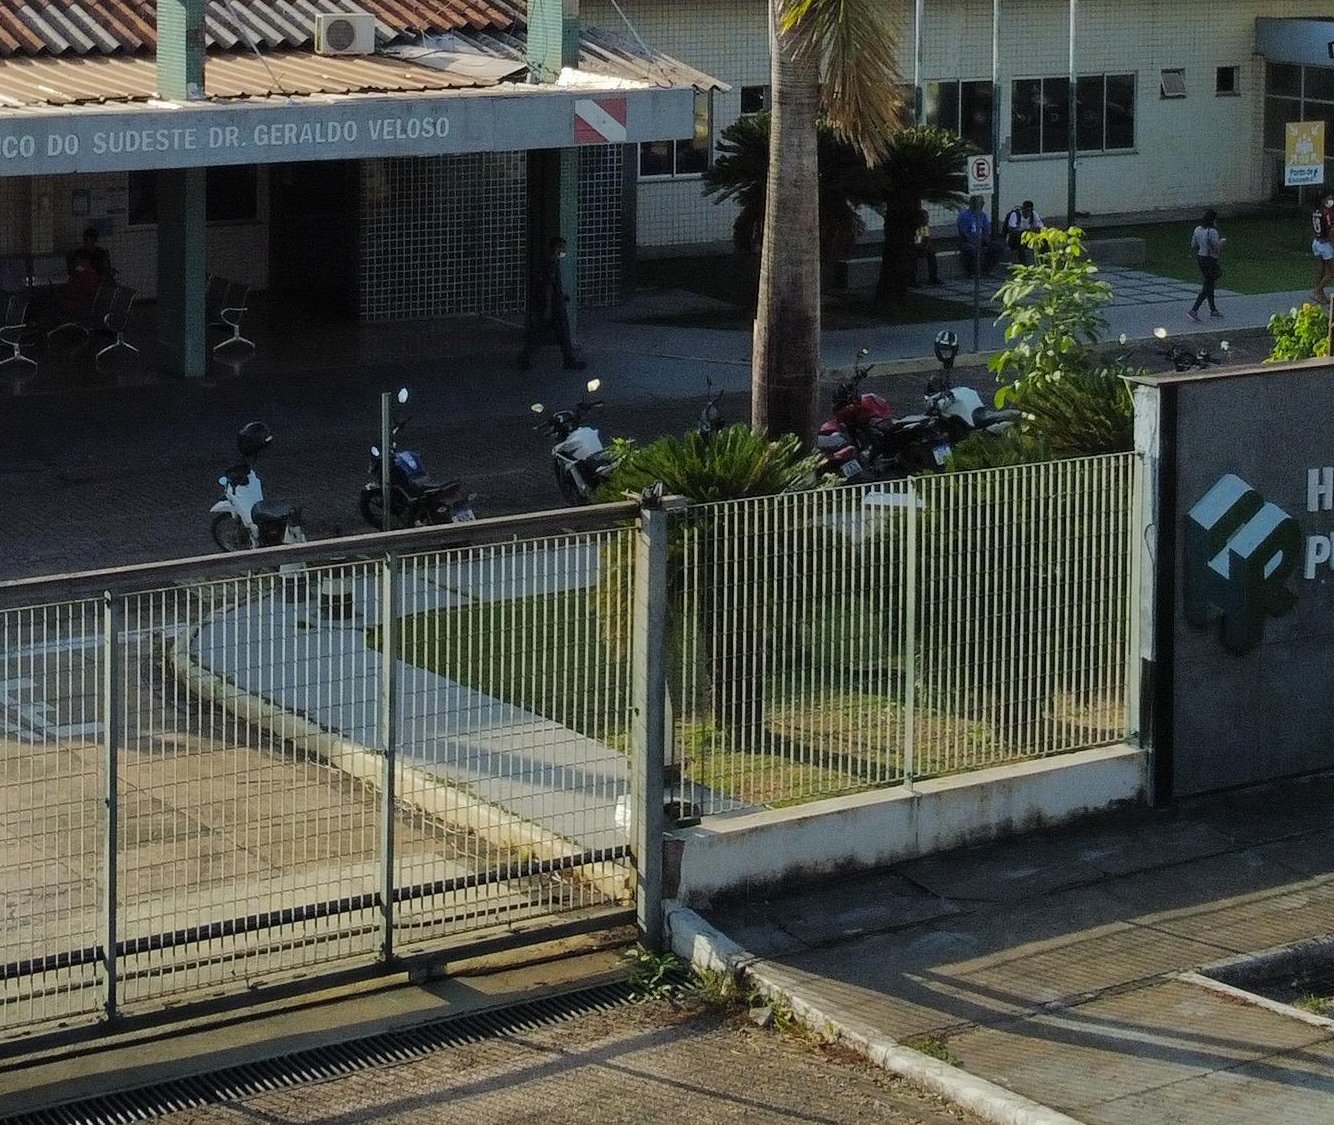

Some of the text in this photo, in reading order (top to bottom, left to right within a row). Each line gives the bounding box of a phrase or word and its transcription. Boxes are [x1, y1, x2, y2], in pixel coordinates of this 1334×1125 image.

[47, 134, 80, 157] DO
[92, 129, 198, 155] SUDESTE
[209, 126, 247, 148] DR.
[253, 120, 358, 146] GERALDO
[369, 116, 450, 140] VELOSO
